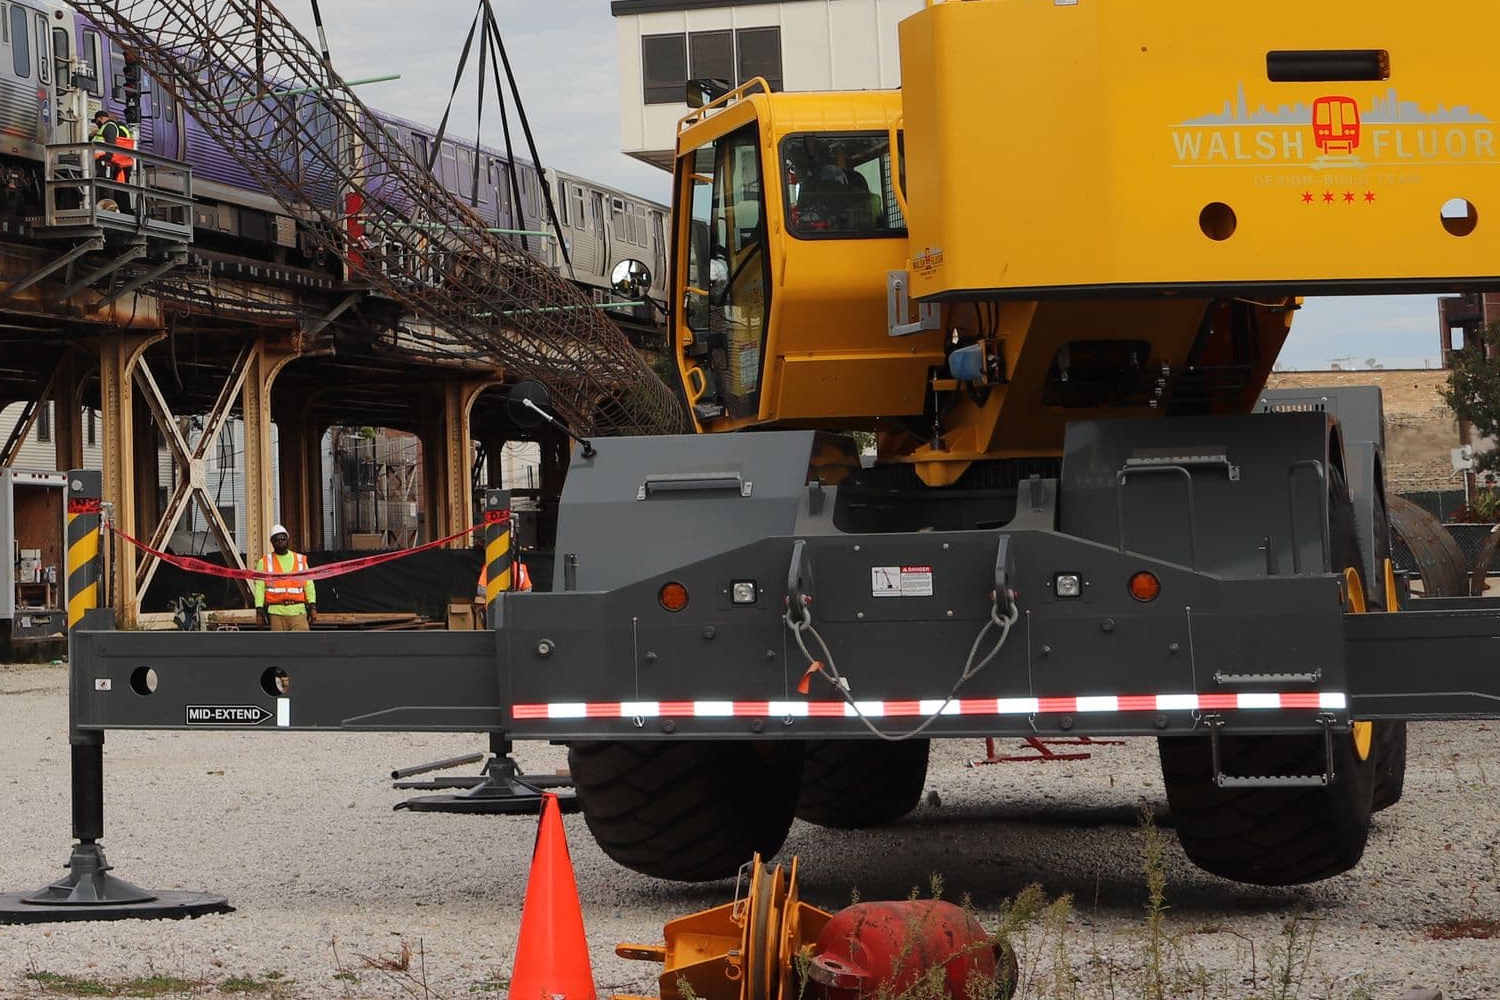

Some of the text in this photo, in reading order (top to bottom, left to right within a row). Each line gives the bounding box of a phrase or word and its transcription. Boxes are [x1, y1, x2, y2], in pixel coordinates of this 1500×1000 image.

[1171, 128, 1496, 160] WALSH FLUOR
[189, 708, 261, 720] MID-EXTEND
